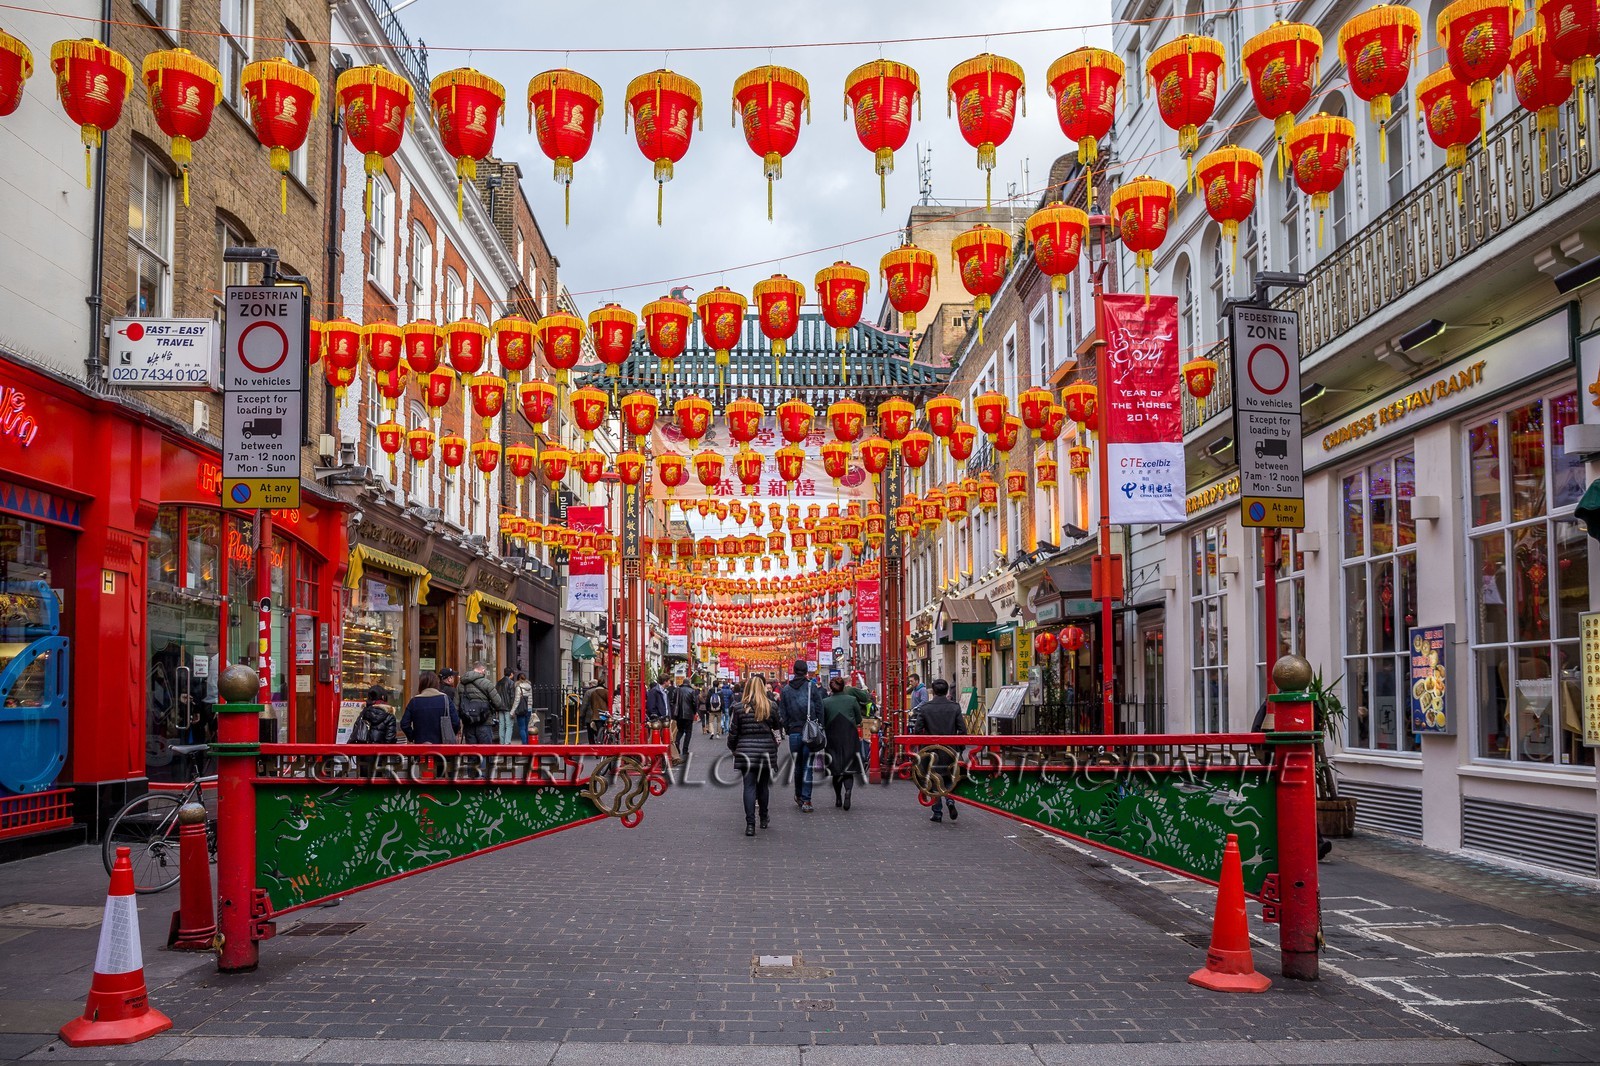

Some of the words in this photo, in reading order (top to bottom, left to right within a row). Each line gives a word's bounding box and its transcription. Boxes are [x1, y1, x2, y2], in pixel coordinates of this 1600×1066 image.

[231, 292, 298, 300] PEDESTRIAN
[240, 304, 288, 317] ZONE
[1238, 313, 1294, 325] PEDESTRIAN
[146, 326, 171, 334] FAST
[179, 327, 206, 335] EASY
[1247, 325, 1287, 340] ZONE
[156, 338, 194, 347] TRAVEL
[113, 368, 138, 381] 020
[141, 368, 174, 381] 7434
[176, 369, 208, 382] 0102
[234, 378, 248, 386] No
[251, 377, 291, 386] vehicles
[1120, 389, 1147, 397] YEAR
[237, 395, 271, 404] Except
[274, 395, 288, 403] for
[1246, 398, 1258, 406] No
[1260, 399, 1293, 408] vehicles
[1136, 400, 1173, 409] HORSE
[237, 406, 273, 415] loading
[275, 406, 288, 415] by
[1126, 413, 1160, 422] 2014
[1249, 415, 1277, 425] Except
[1279, 416, 1291, 425] for
[1249, 426, 1279, 437] loading
[1281, 428, 1291, 437] by
[1322, 412, 1376, 451] CHINESE
[241, 442, 283, 450] between
[228, 453, 249, 461] 7am
[258, 453, 269, 461] 12
[1120, 457, 1171, 468] CTExcelbiz
[1254, 461, 1288, 470] between
[237, 464, 258, 472] Mon
[266, 464, 286, 472] Sun
[1244, 472, 1262, 480] 7am
[1269, 473, 1278, 481] 12
[275, 485, 292, 493] any
[1253, 483, 1270, 492] Mon
[1276, 484, 1292, 492] Sun
[265, 494, 287, 503] time
[1272, 503, 1281, 511] At
[1283, 505, 1298, 513] any
[1276, 514, 1294, 523] time
